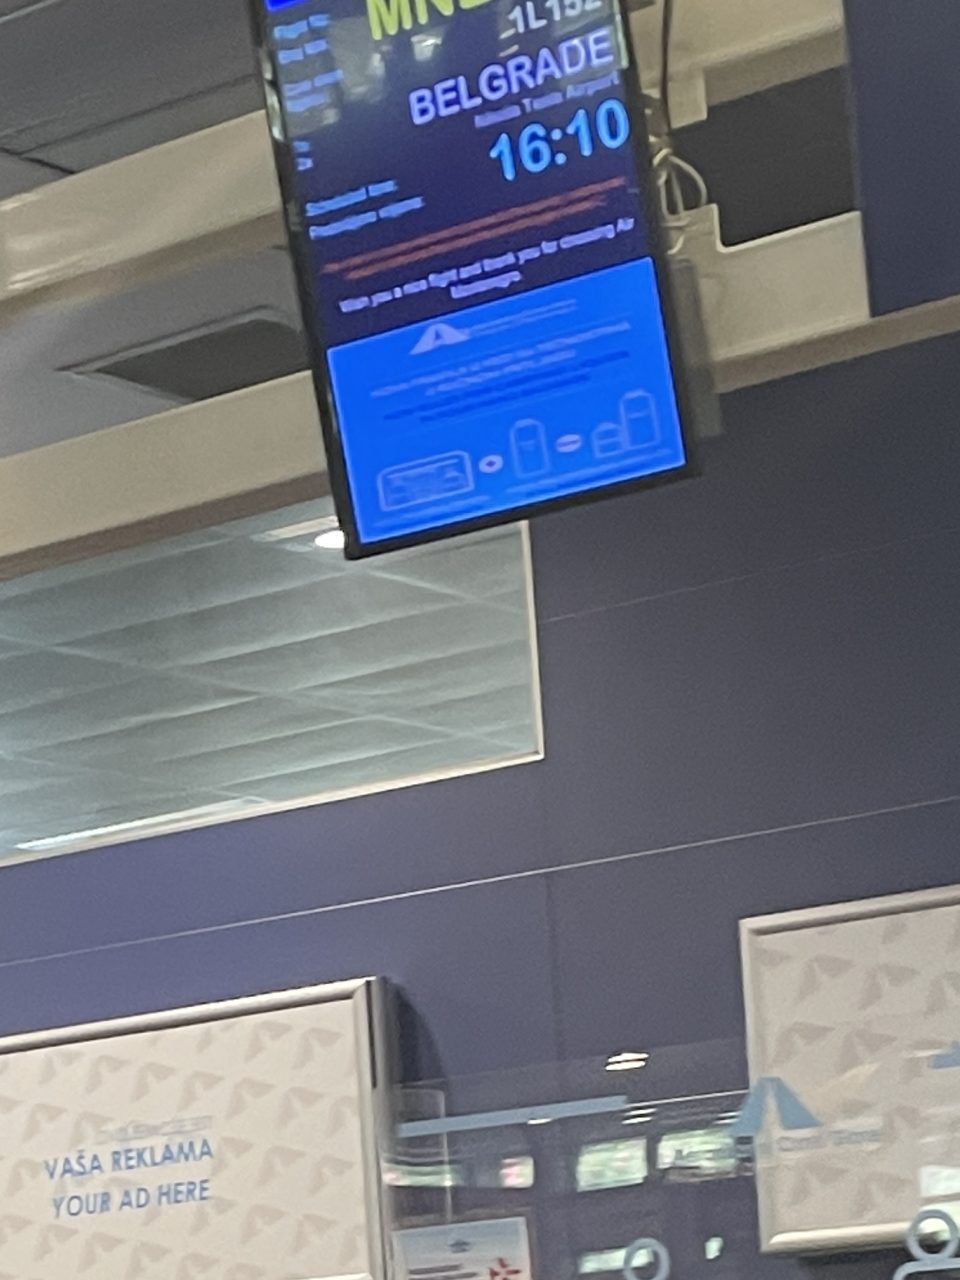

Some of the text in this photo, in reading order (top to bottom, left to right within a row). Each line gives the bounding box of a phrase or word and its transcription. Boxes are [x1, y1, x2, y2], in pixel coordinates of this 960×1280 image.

[409, 26, 614, 125] BELGRADE
[490, 99, 630, 181] 16:10
[43, 1138, 214, 1179] VAŠA REKLAMA
[52, 1179, 210, 1219] YOUR AD HERE
